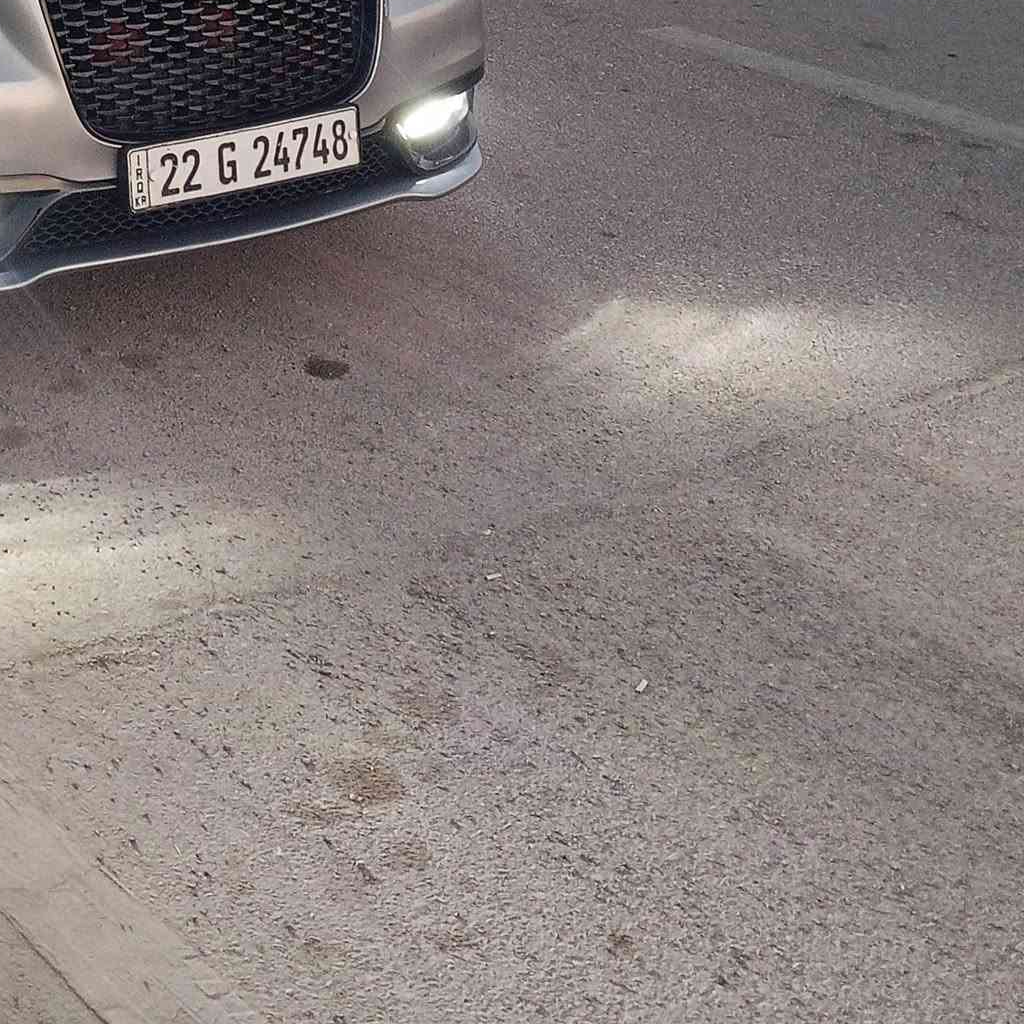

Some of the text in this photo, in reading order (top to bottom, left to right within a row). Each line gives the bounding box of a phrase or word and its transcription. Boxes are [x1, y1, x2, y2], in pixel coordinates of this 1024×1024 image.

[160, 119, 349, 197] 22 G 24748
